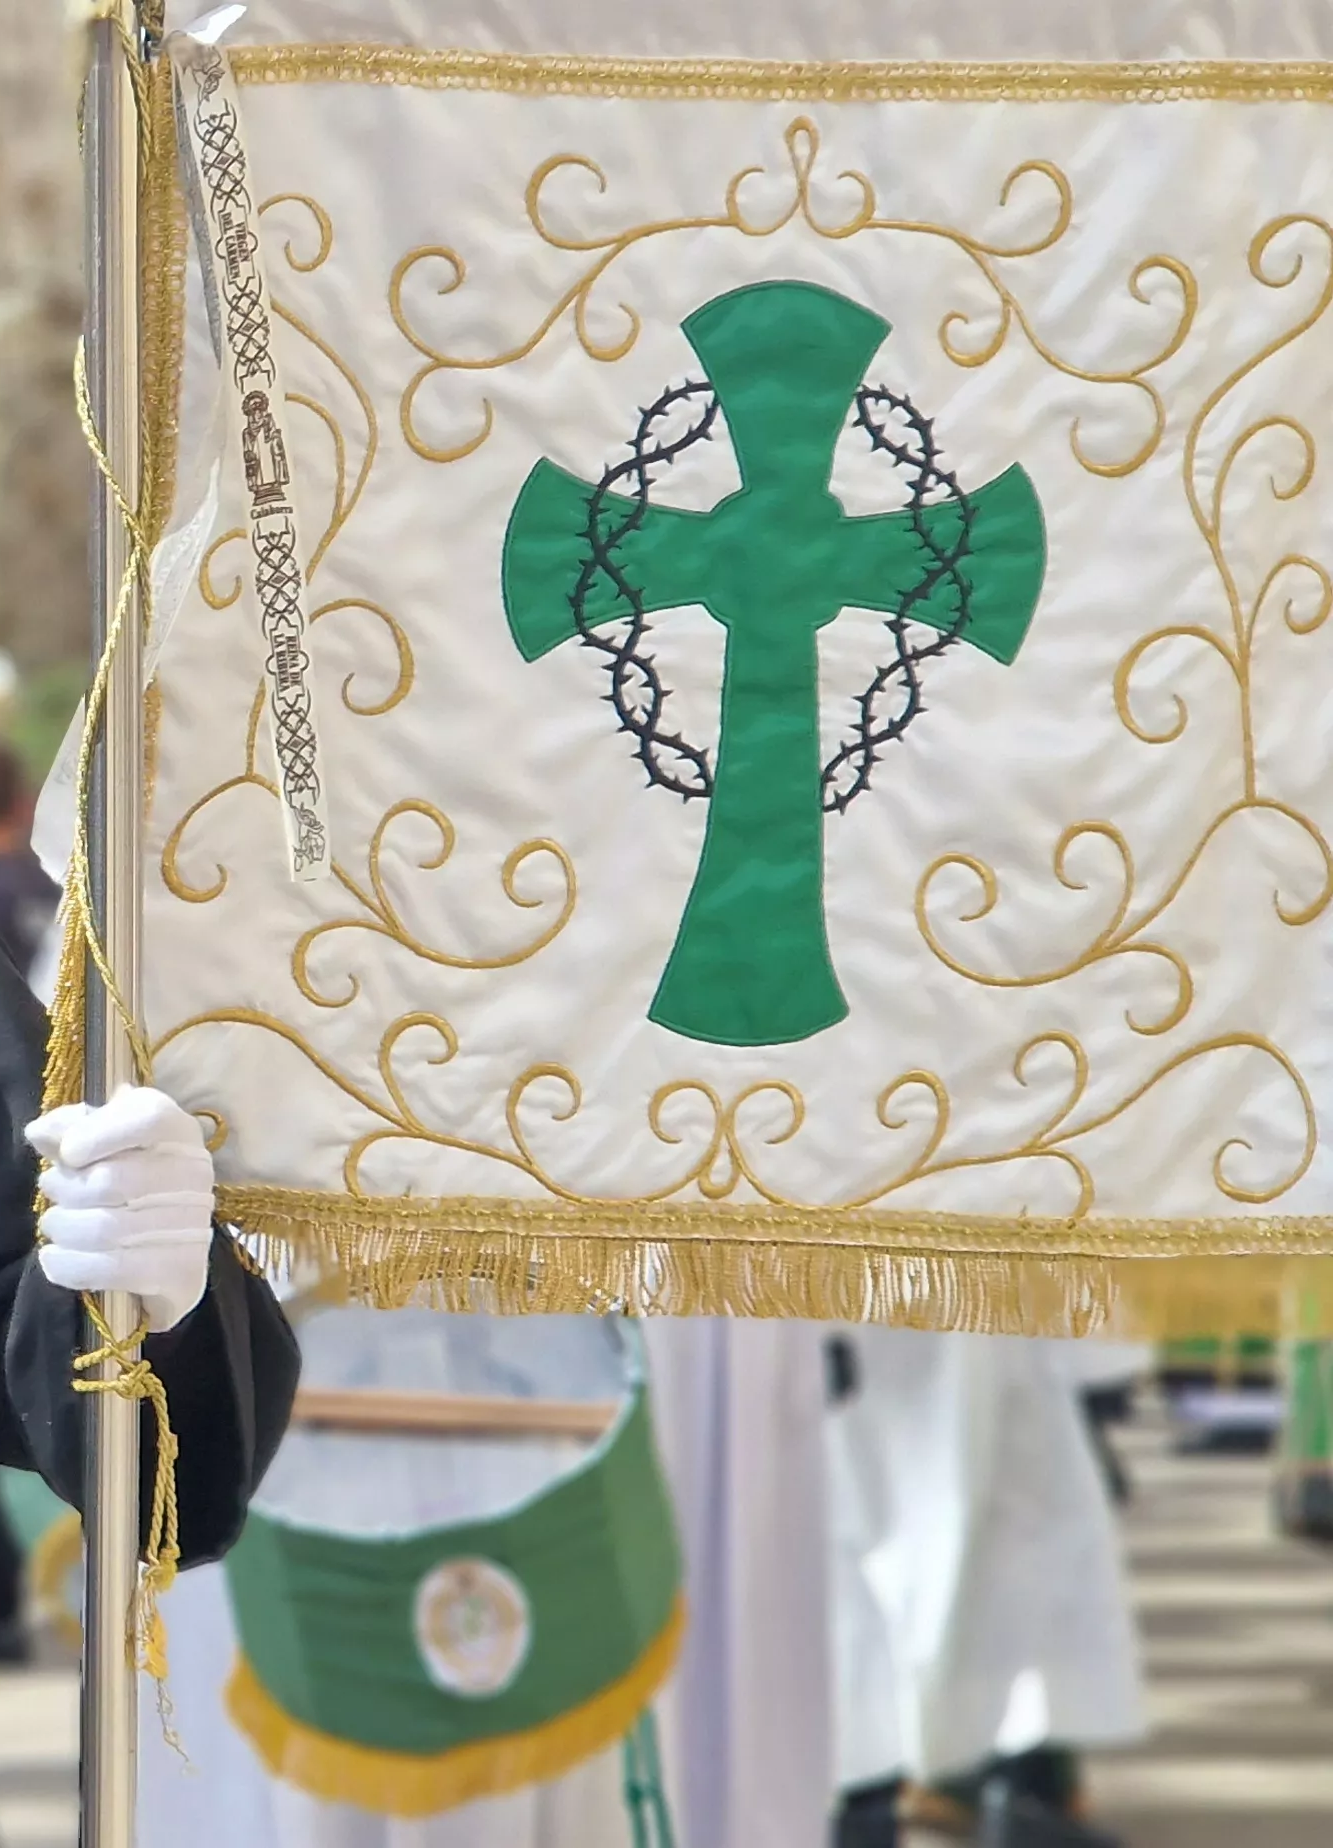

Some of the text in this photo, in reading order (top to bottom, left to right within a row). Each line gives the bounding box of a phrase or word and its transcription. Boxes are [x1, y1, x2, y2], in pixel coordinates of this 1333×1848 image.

[221, 212, 241, 279] DEL CARMEN
[235, 221, 250, 262] VIRGEN
[250, 505, 293, 520] Calahorra
[274, 633, 290, 692] LA RIBERA
[285, 636, 302, 687] REINA DE
